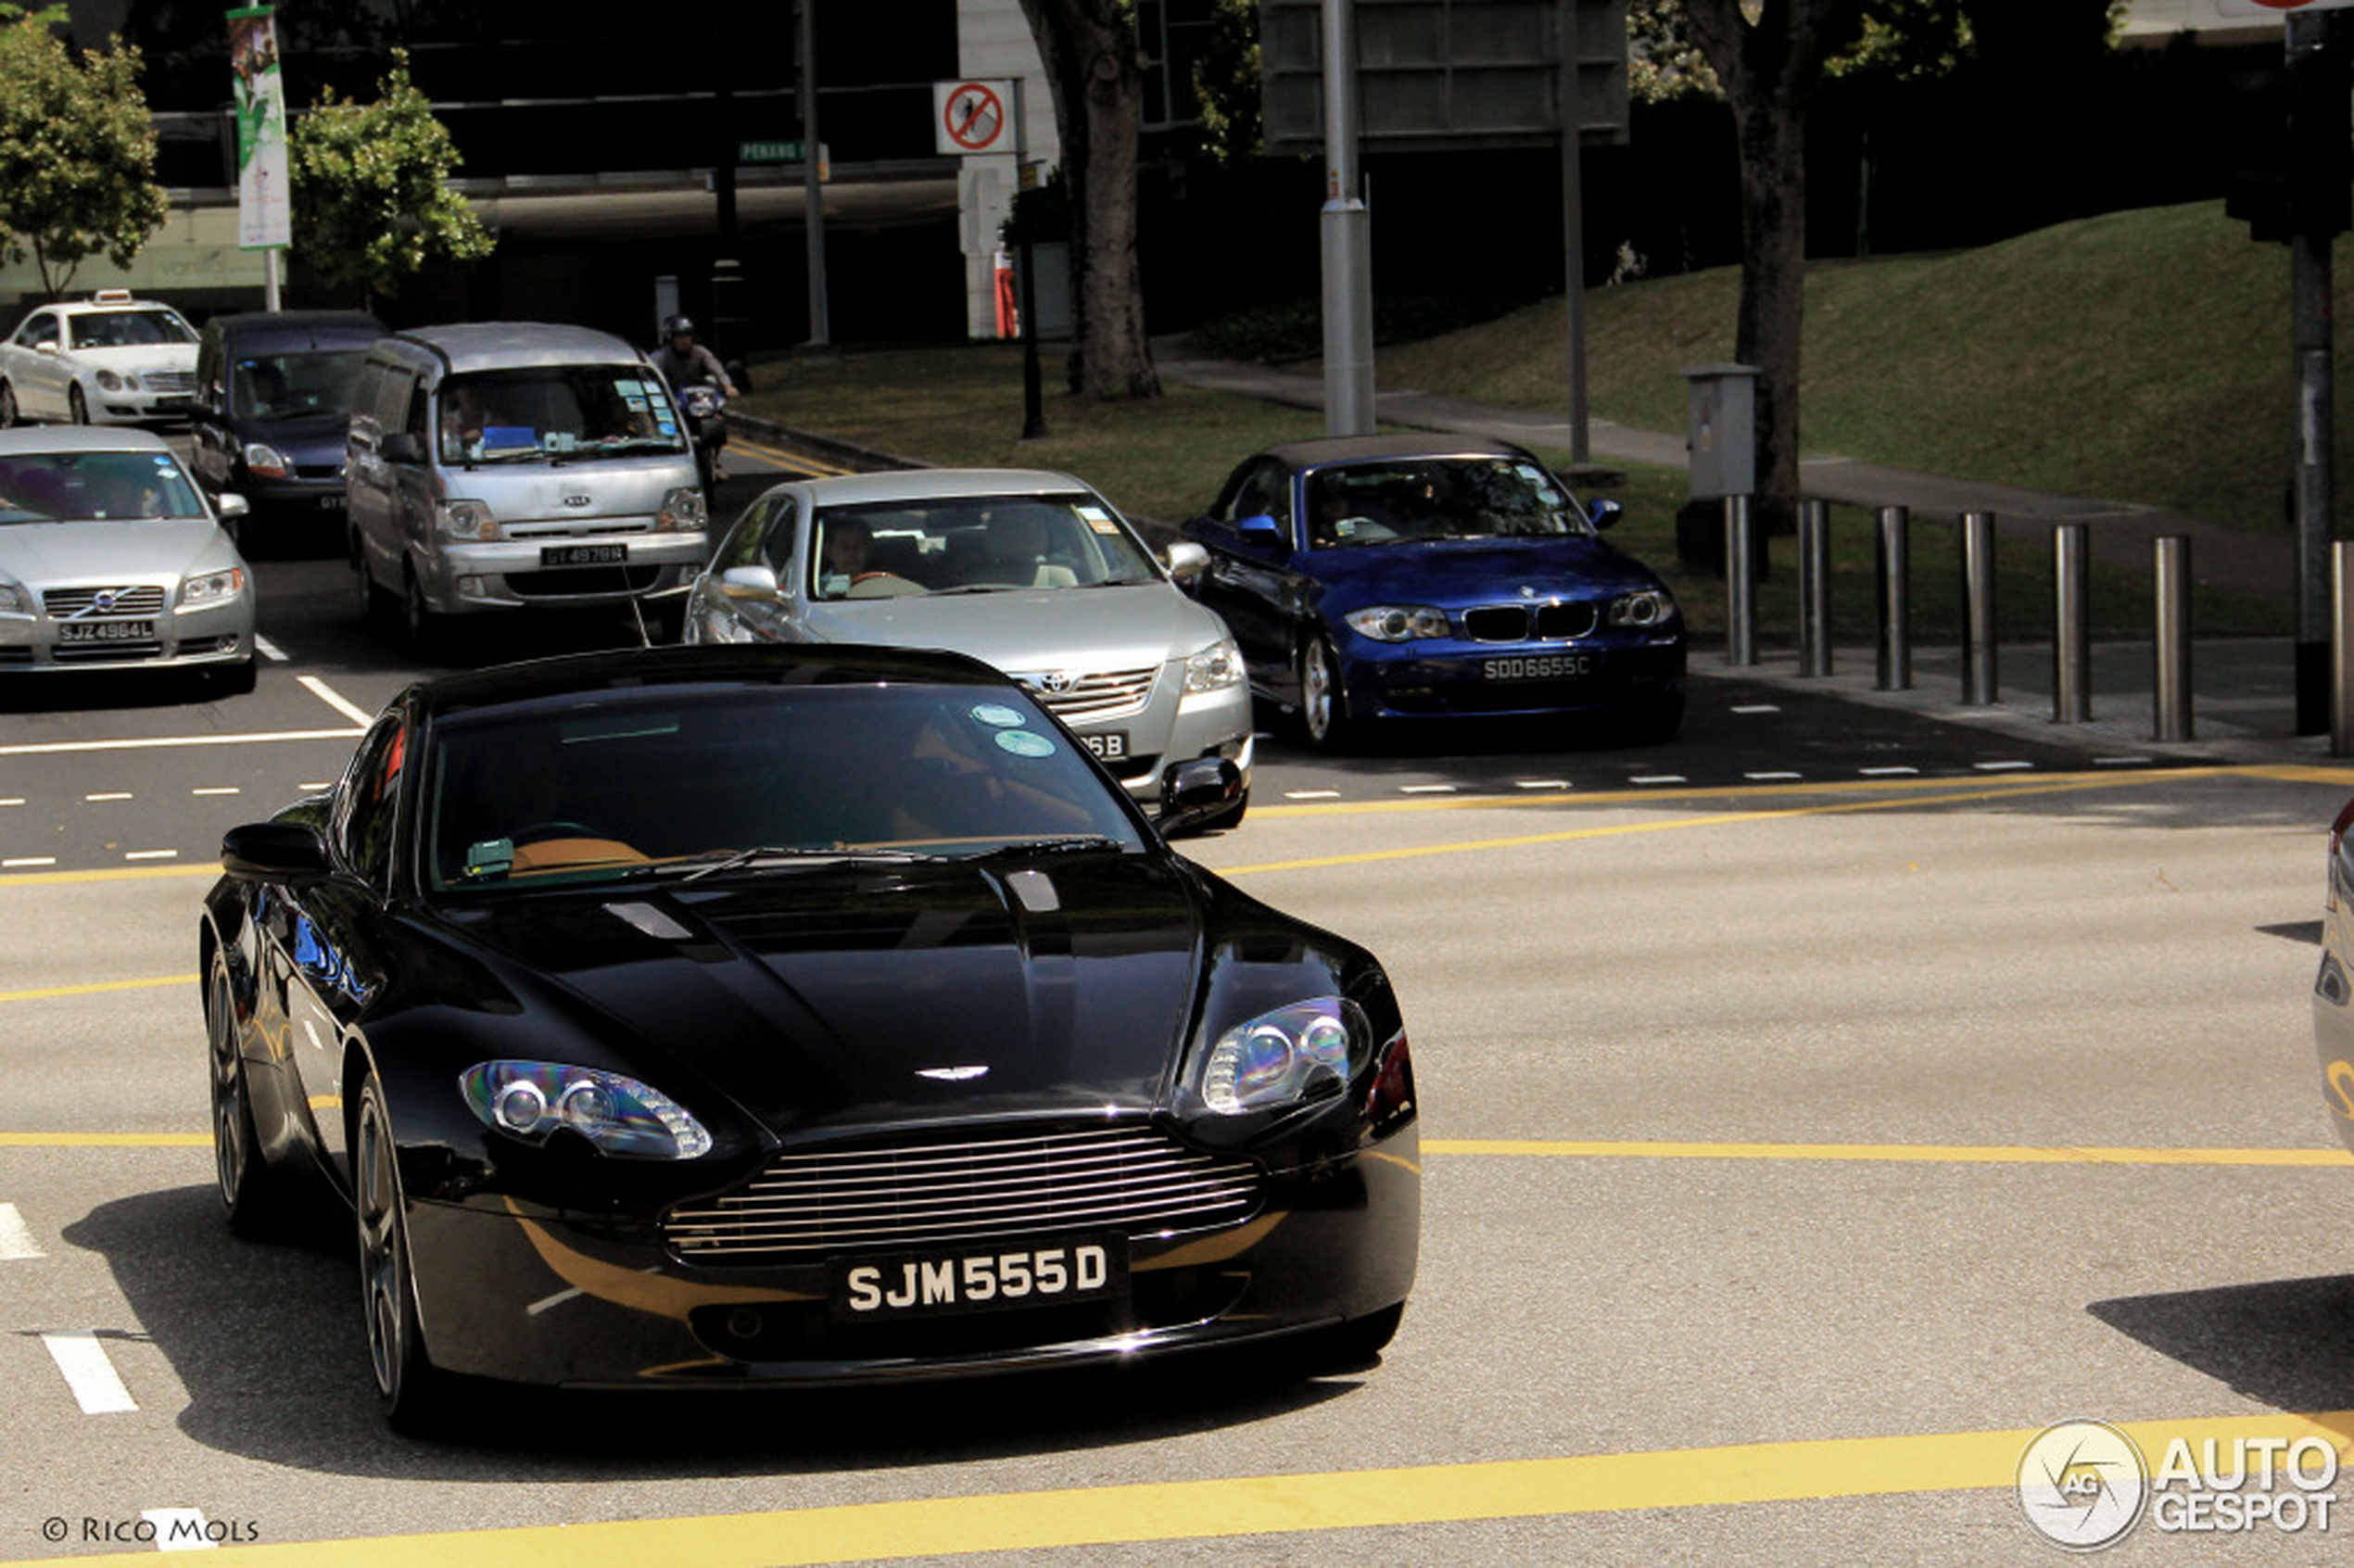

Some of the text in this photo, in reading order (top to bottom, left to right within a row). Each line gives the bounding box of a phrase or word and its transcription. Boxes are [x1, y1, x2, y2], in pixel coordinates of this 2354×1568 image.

[60, 623, 153, 640] SJZ4964L
[1484, 657, 1590, 679] SDD6655C
[1080, 735, 1123, 755] 6B
[848, 1246, 1107, 1311] SJM555D
